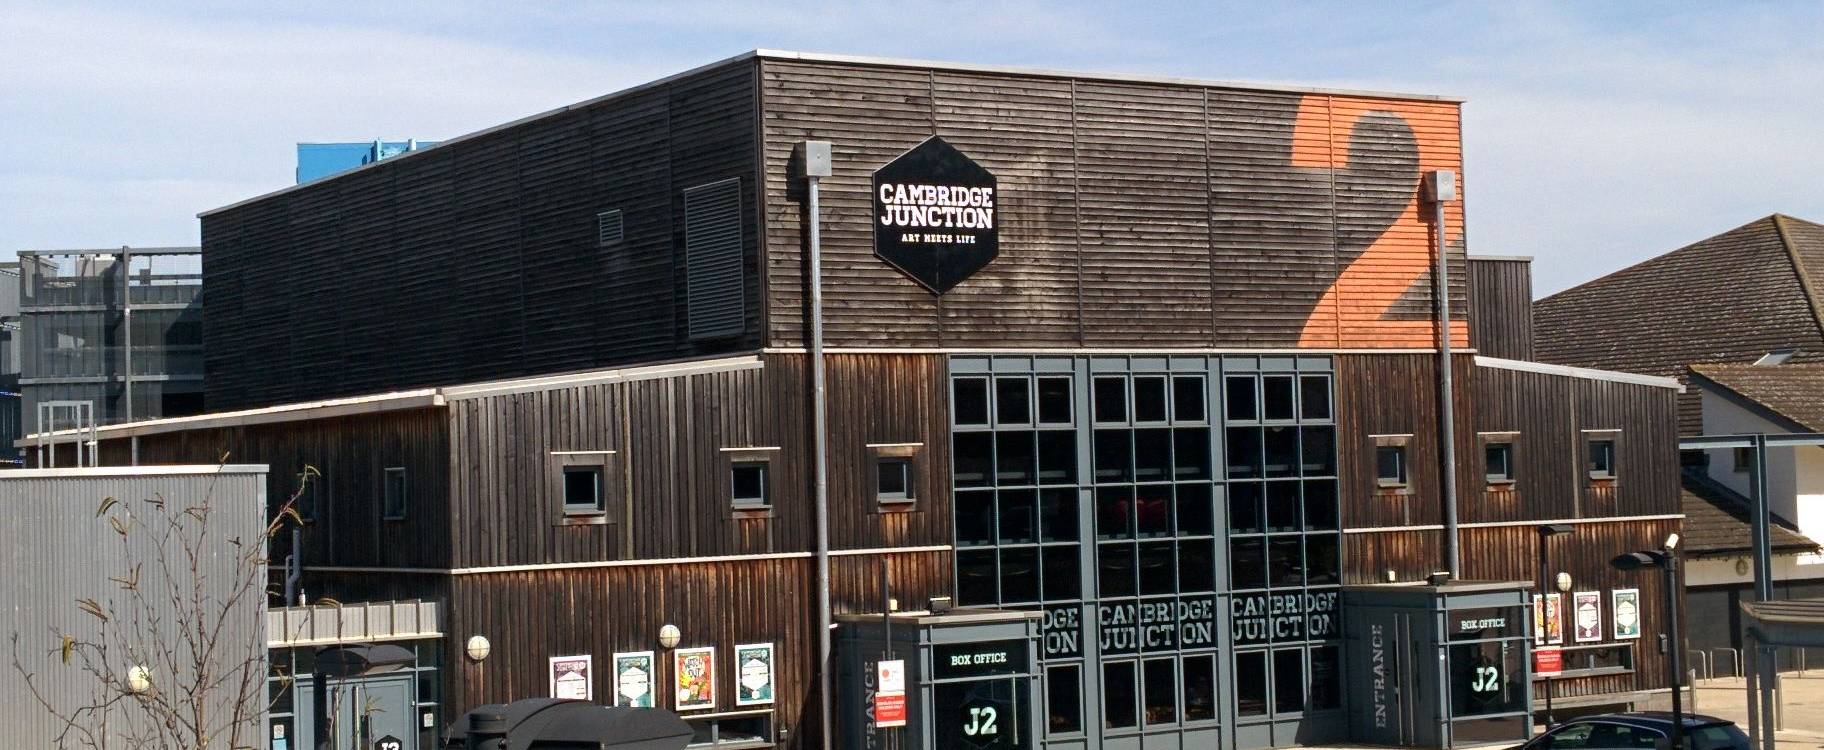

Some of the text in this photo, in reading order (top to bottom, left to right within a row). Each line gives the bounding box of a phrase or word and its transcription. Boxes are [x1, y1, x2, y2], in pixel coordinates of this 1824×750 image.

[880, 184, 993, 208] CAMBRIDGE
[880, 205, 993, 229] JUNCTION
[1292, 95, 1468, 348] 2
[902, 234, 976, 244] ART MEETS LIFE
[1101, 622, 1212, 650] JUNCTON
[1233, 614, 1336, 640] JUNCTON
[1461, 618, 1505, 630] BOX OFFICE
[951, 652, 1007, 666] BOX OFFICE
[1372, 625, 1386, 728] ENTRANCE
[1472, 667, 1498, 692] J2
[964, 707, 997, 736] J2
